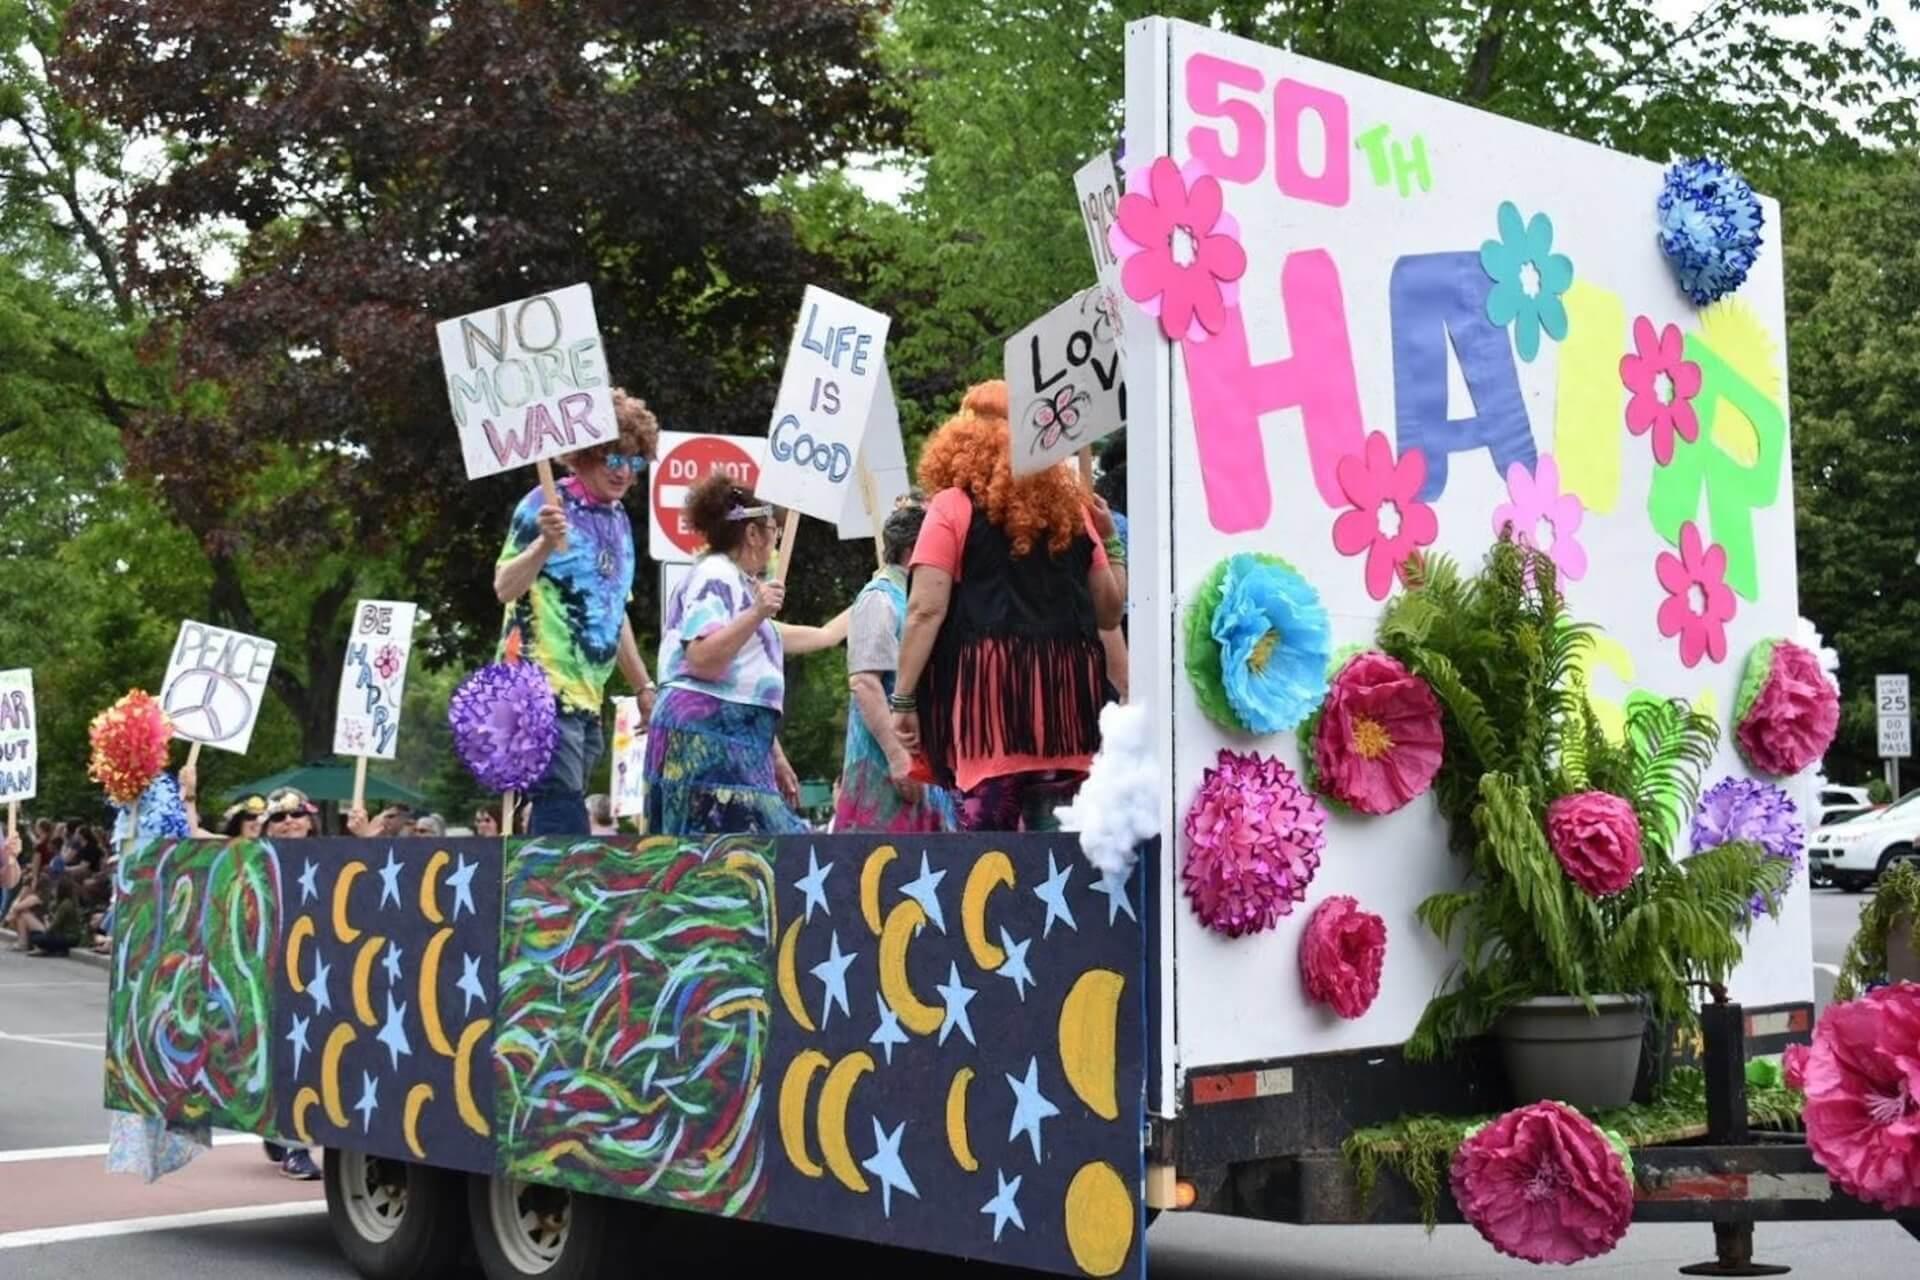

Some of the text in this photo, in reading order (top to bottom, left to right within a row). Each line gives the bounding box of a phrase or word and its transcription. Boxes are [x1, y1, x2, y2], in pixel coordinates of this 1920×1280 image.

[461, 295, 562, 368] NO
[801, 303, 873, 376] LIFE
[449, 337, 600, 427] MORE
[810, 378, 842, 416] IS
[482, 392, 603, 467] WAR
[769, 413, 852, 484] GOOD
[1182, 247, 1786, 603] HAIR
[669, 459, 752, 482] DO NOT
[359, 604, 393, 635] BE
[175, 623, 273, 685] PEACE
[347, 642, 396, 754] HAPPY
[1881, 695, 1906, 711] 25
[1886, 719, 1902, 729] DO
[1881, 743, 1908, 753] PASS
[1883, 731, 1904, 741] NOT
